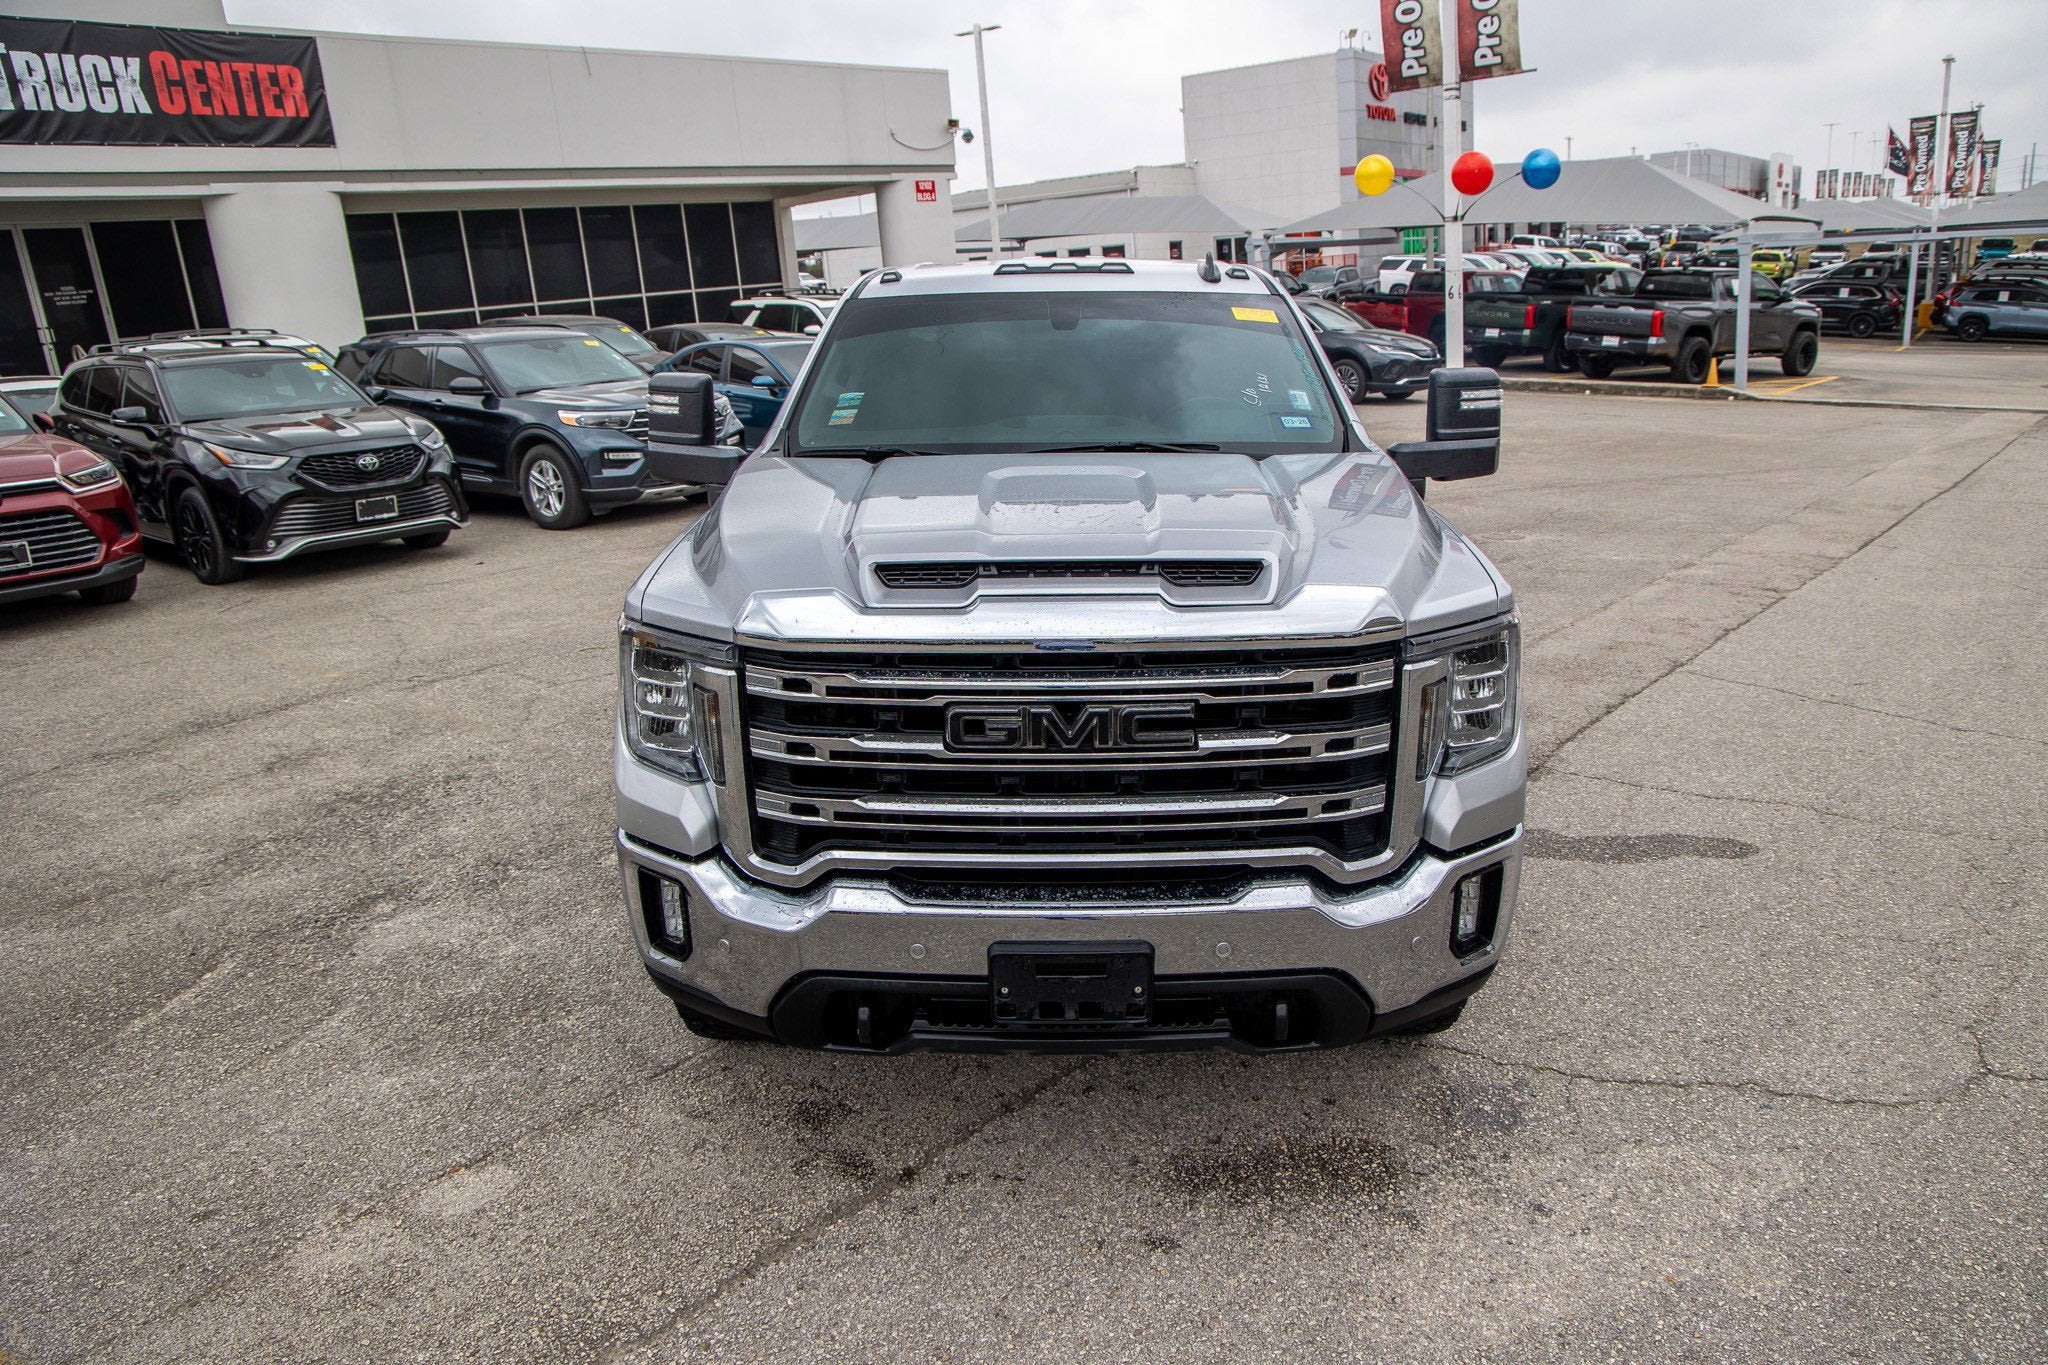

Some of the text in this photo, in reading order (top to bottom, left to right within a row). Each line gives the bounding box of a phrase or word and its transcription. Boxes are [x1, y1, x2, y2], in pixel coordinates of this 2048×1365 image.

[1401, 28, 1428, 78] Pre
[1474, 14, 1502, 68] Pre
[149, 51, 310, 118] CENTER
[1366, 103, 1397, 122] TOYOTA
[1914, 135, 1929, 173] Owned
[1953, 130, 1969, 170] Owned
[945, 703, 1196, 750] GMC
